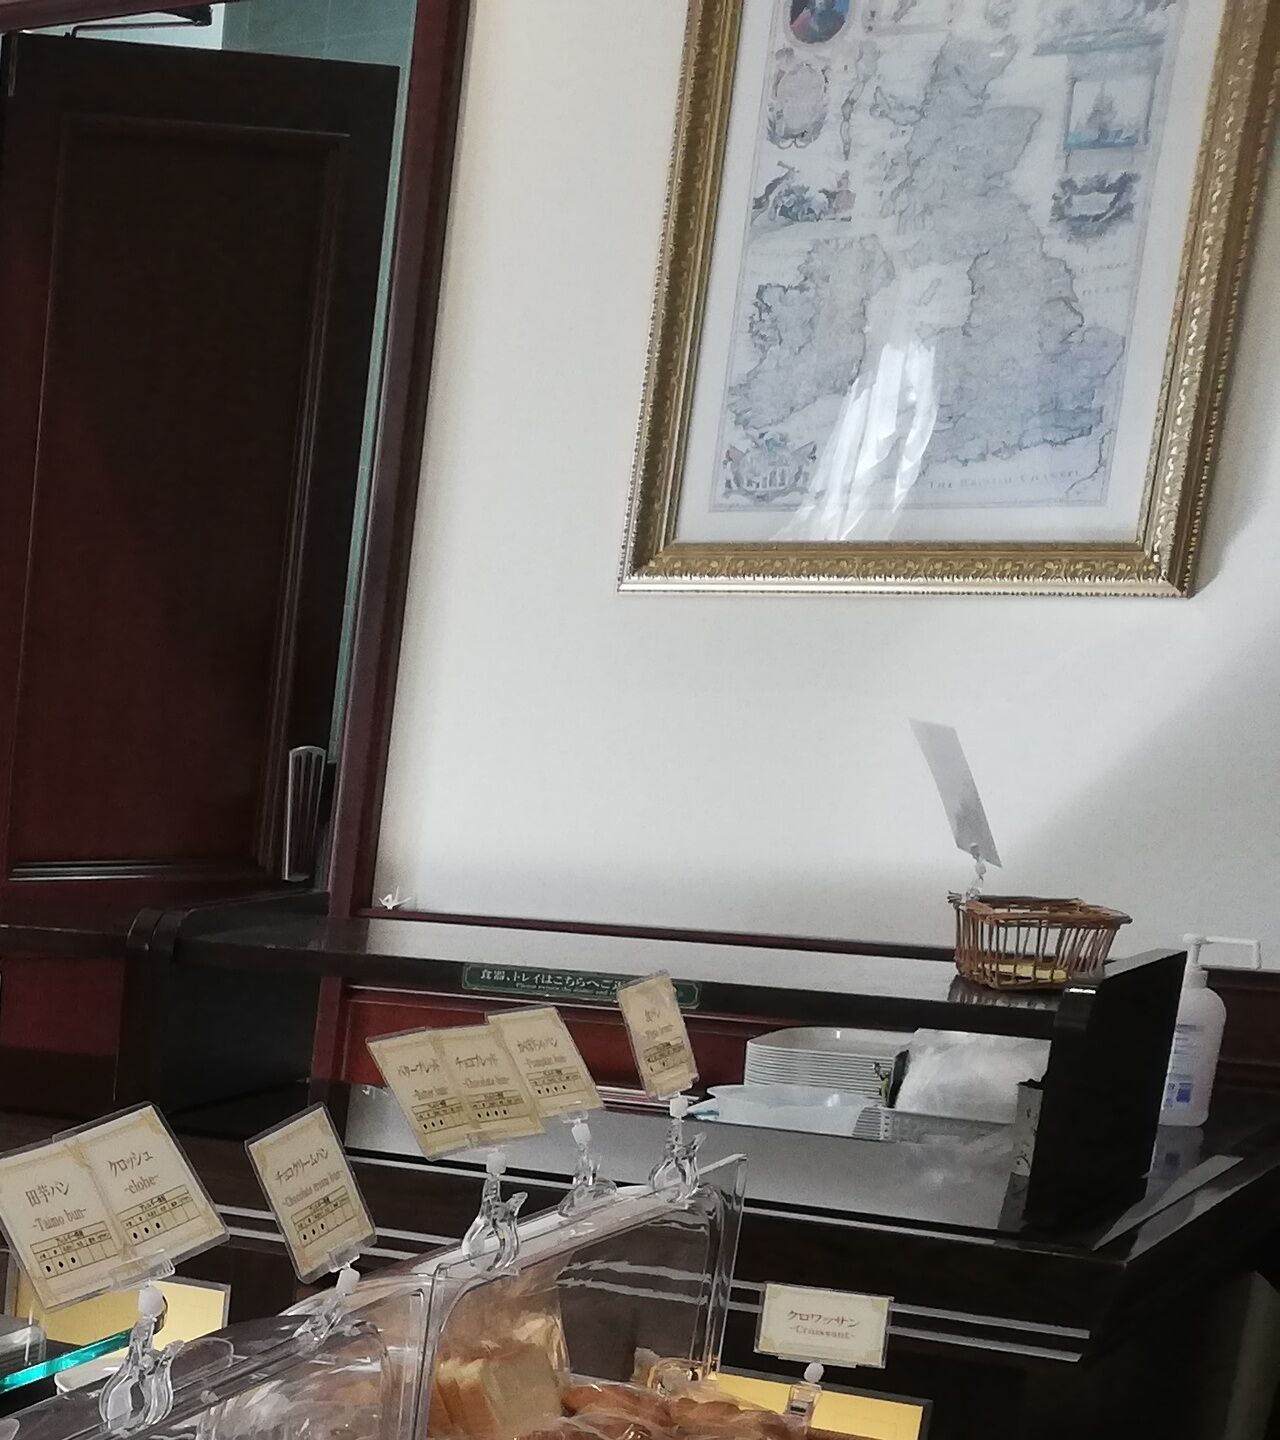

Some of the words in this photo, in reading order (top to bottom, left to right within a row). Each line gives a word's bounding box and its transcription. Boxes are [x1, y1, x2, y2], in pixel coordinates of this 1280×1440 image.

[24, 1180, 70, 1208] 田芋パン
[787, 1309, 862, 1328] クロワッサン
